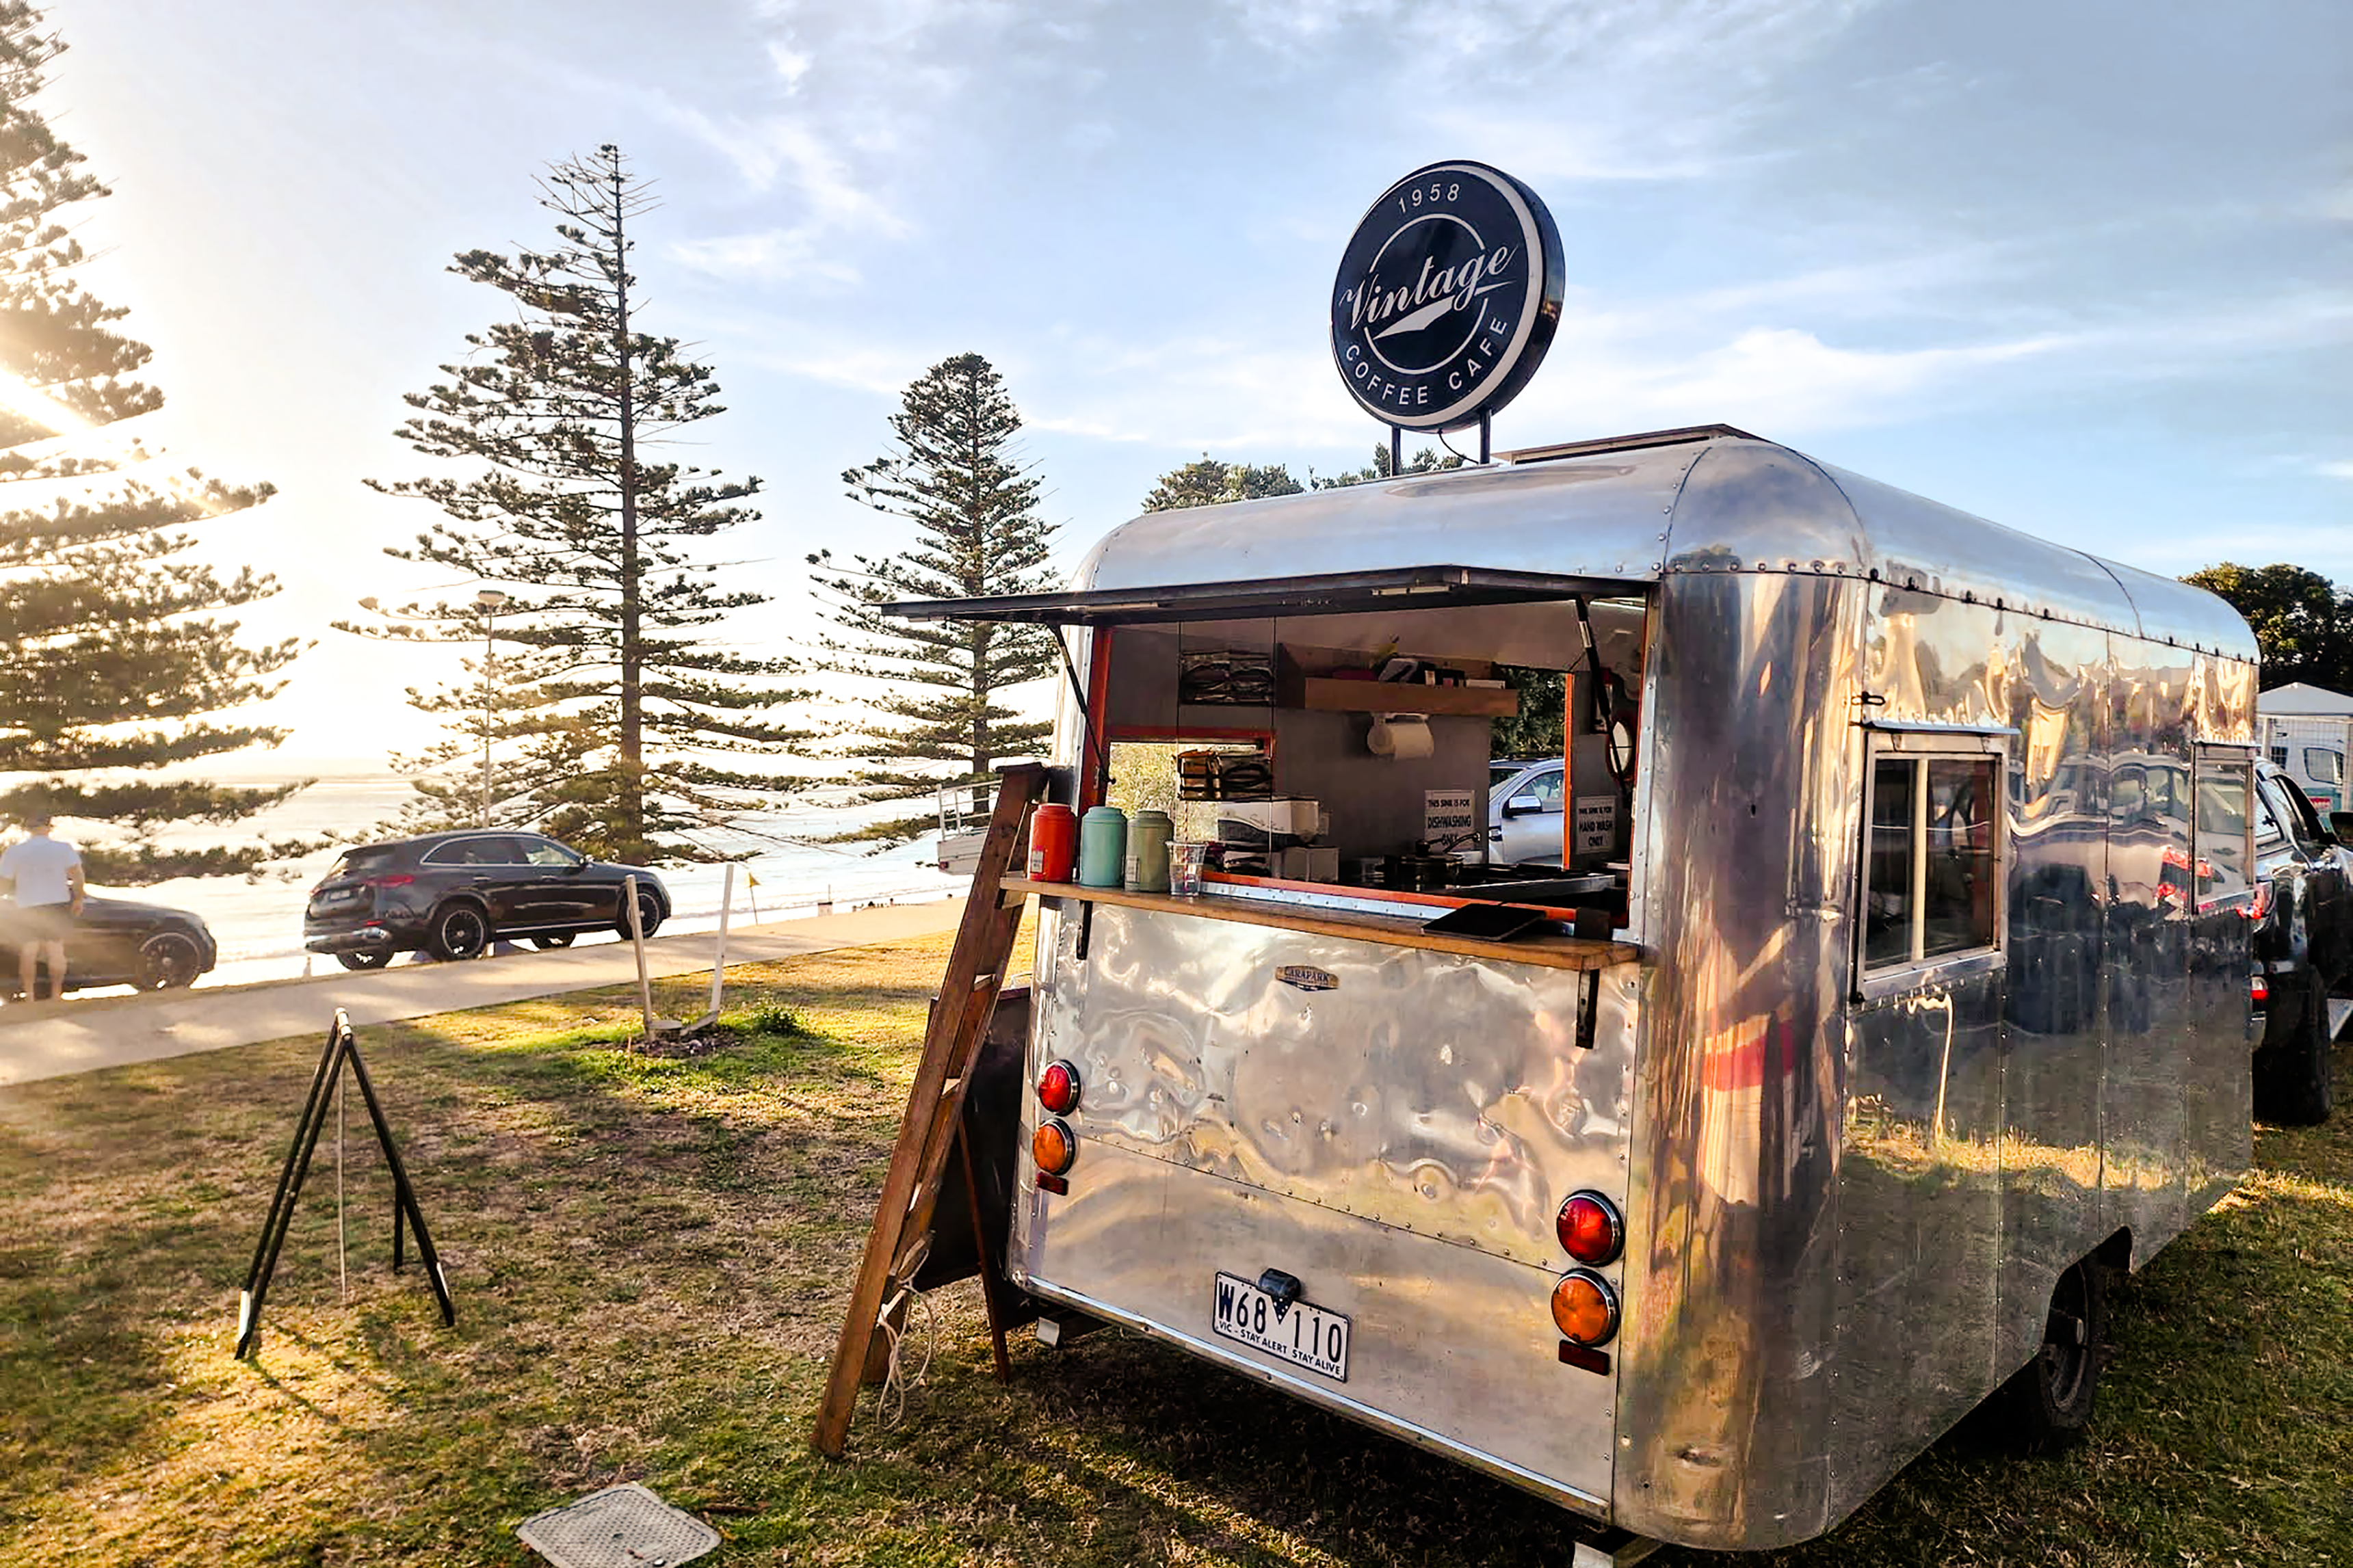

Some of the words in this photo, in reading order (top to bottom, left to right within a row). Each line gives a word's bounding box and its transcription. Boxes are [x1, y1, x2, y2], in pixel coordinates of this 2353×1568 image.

[1398, 183, 1460, 213] 1958
[1339, 245, 1519, 330] Vintage
[1345, 345, 1428, 405] COFFEE
[1449, 317, 1508, 390] CAFE
[1219, 1281, 1266, 1333] W68
[1294, 1310, 1342, 1362] 110
[1219, 1320, 1232, 1333] VIC
[1241, 1329, 1260, 1343] STAY
[1262, 1338, 1287, 1353] ALERT
[1292, 1348, 1313, 1364] STAY
[1315, 1359, 1341, 1374] ALIVE
